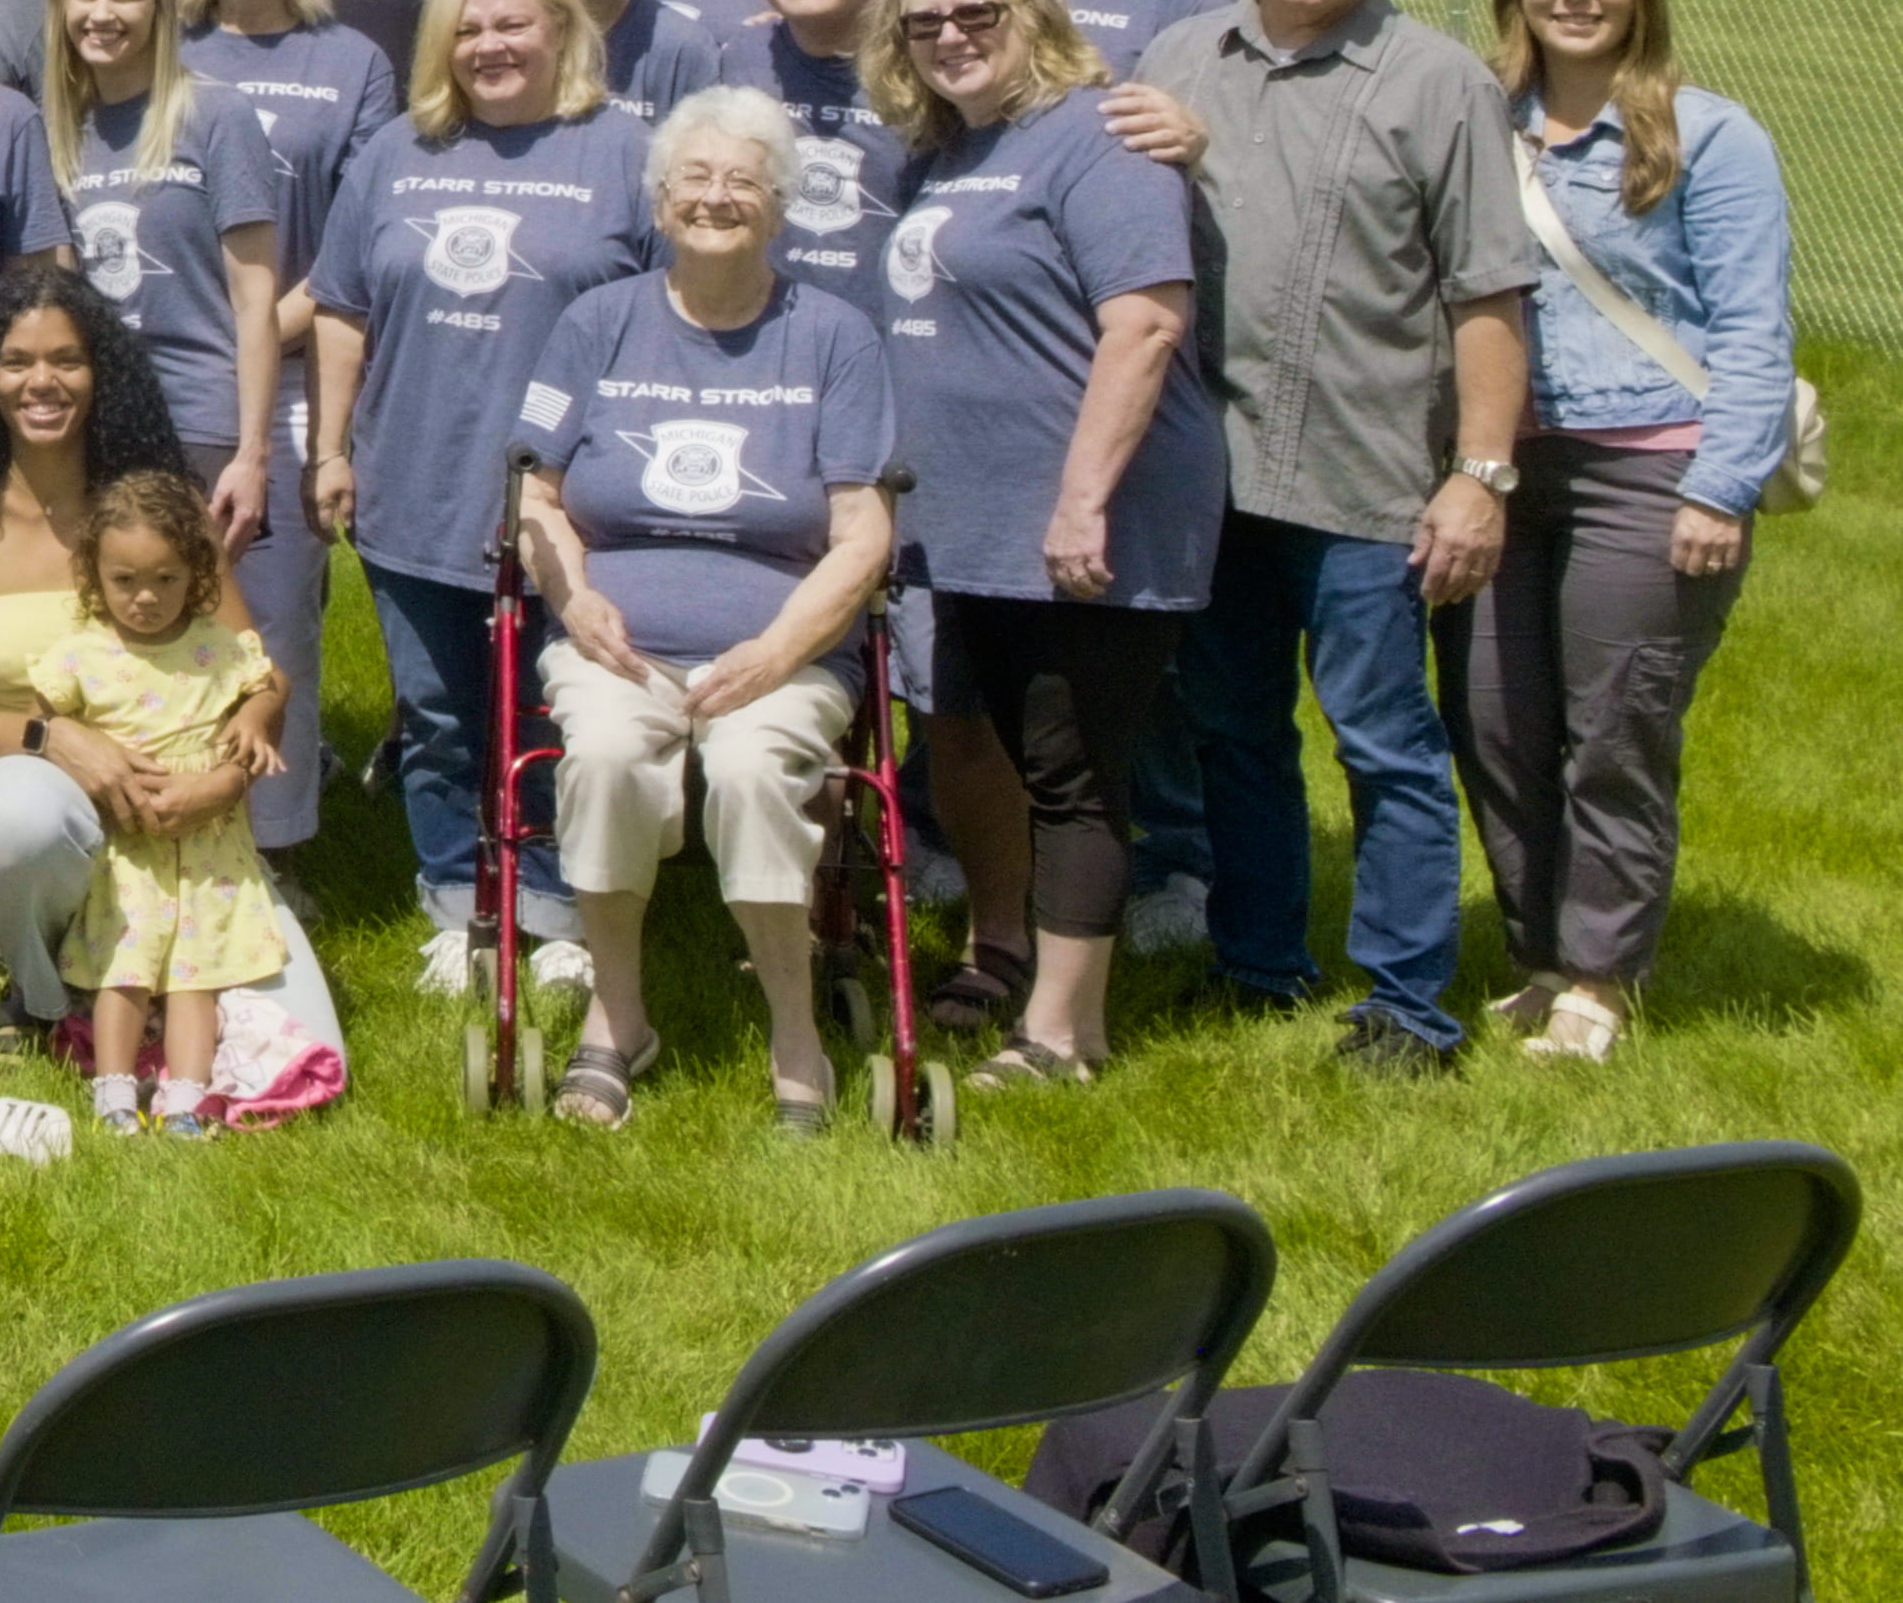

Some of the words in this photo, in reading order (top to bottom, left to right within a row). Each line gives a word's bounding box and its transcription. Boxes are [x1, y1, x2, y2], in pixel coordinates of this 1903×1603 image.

[1069, 9, 1130, 29] ONG
[236, 81, 339, 102] STRONG
[393, 176, 476, 194] STARR
[483, 179, 592, 203] STRONG
[786, 247, 857, 268] #485
[426, 308, 501, 331] #485
[892, 318, 937, 337] #485
[597, 379, 692, 403] STARR
[699, 385, 814, 406] STRONG
[659, 429, 740, 448] MICHIGAN
[648, 480, 682, 501] STATE
[689, 484, 735, 503] POLICE
